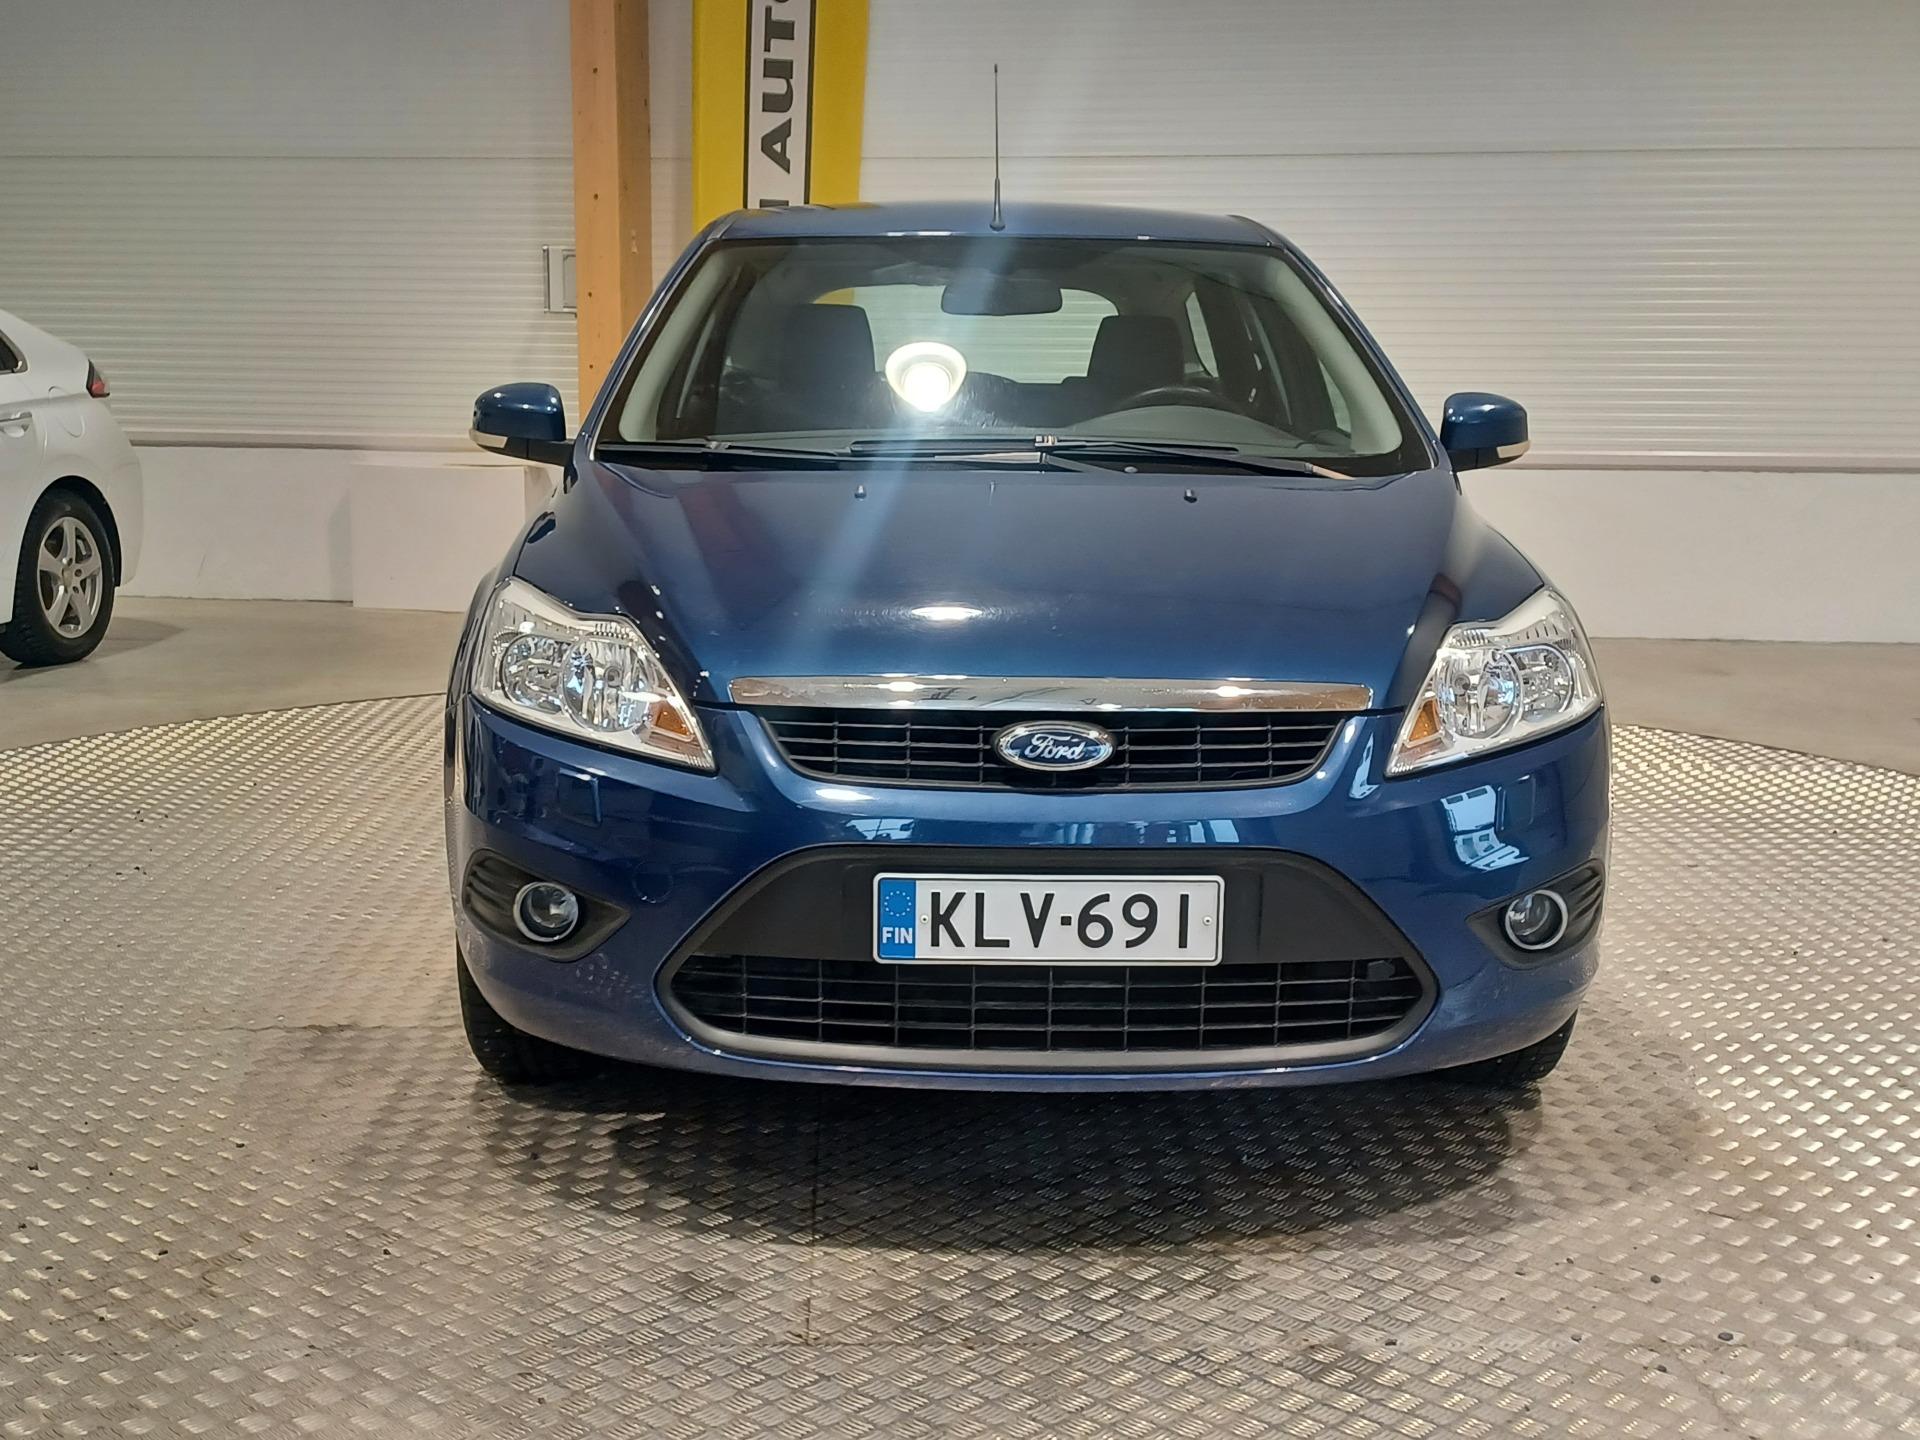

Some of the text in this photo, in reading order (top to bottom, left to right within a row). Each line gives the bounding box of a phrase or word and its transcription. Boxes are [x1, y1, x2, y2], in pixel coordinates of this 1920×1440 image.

[761, 0, 795, 174] AUT
[1024, 733, 1086, 760] Ford
[882, 926, 913, 944] FIN
[930, 891, 1190, 949] KLV-691
